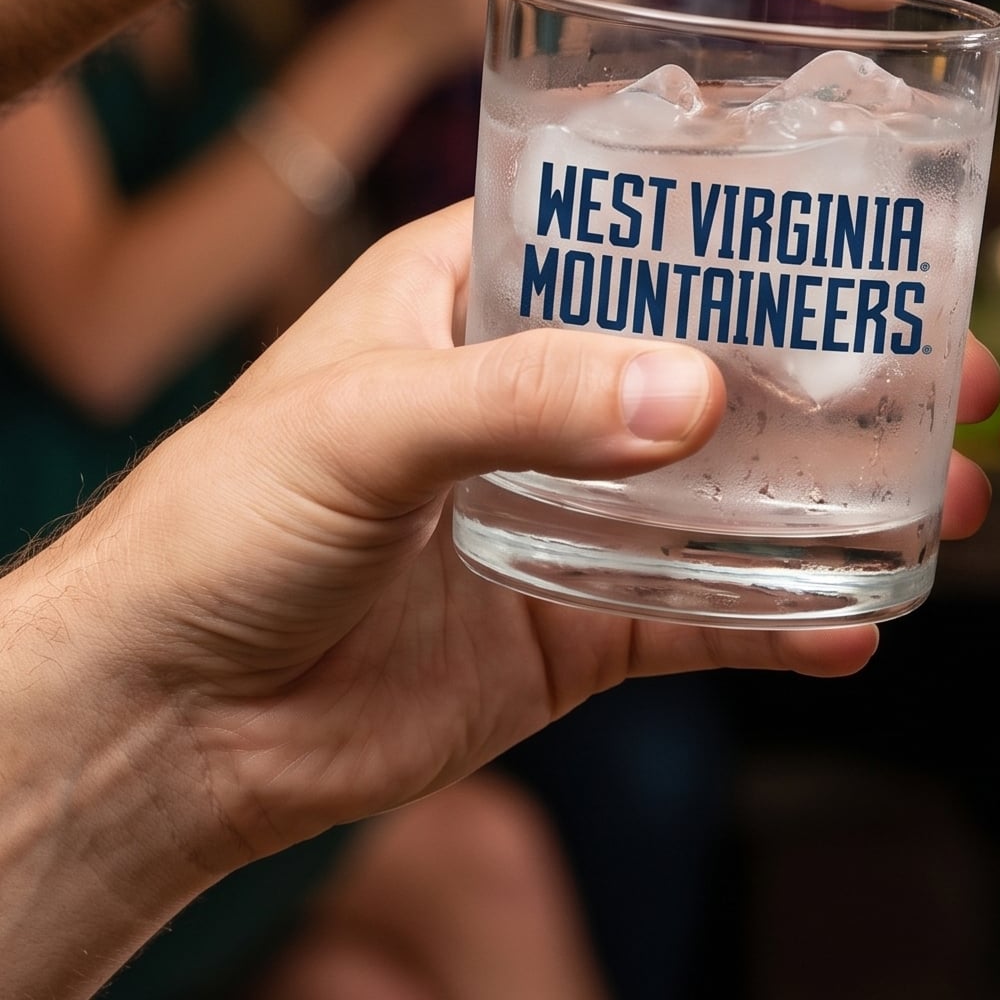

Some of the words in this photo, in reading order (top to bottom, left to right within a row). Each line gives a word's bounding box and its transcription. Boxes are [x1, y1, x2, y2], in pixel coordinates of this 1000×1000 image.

[537, 161, 677, 251] WEST
[691, 181, 925, 271] VIRGINIA
[520, 244, 926, 355] MOUNTAINEERS
